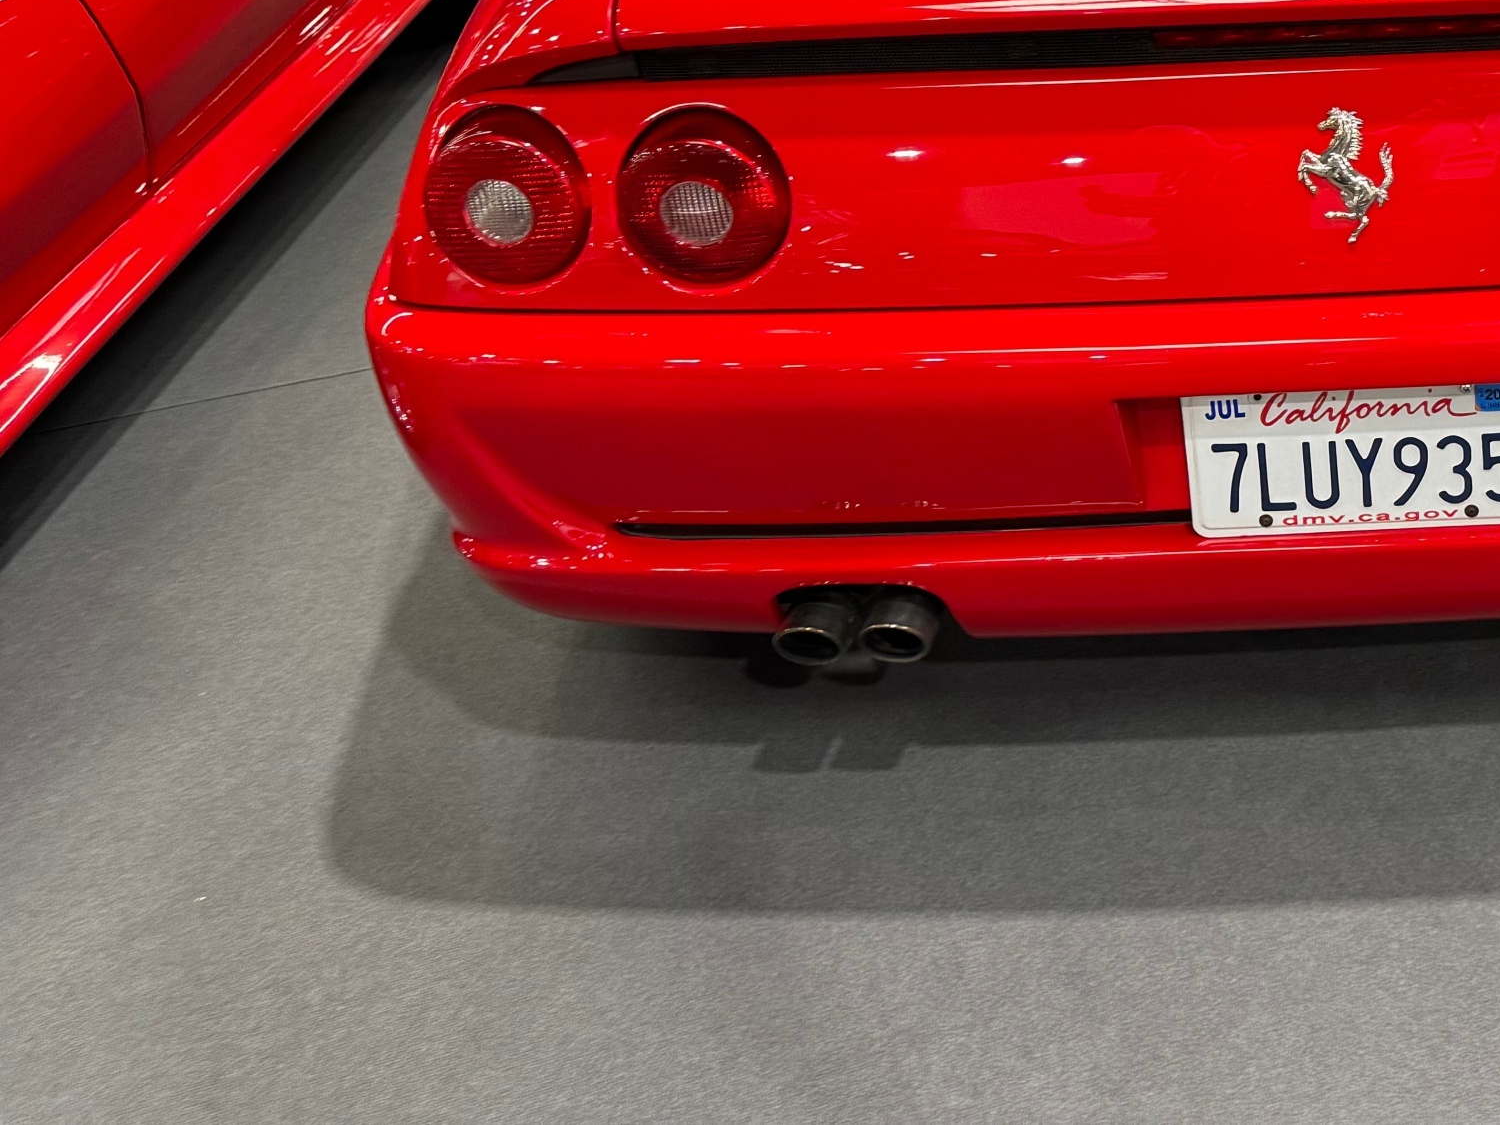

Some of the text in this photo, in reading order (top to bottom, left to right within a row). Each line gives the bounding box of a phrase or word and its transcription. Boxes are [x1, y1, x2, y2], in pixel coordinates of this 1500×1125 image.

[1204, 389, 1478, 434] JUL California
[1282, 508, 1459, 526] dmv.ca.gov
